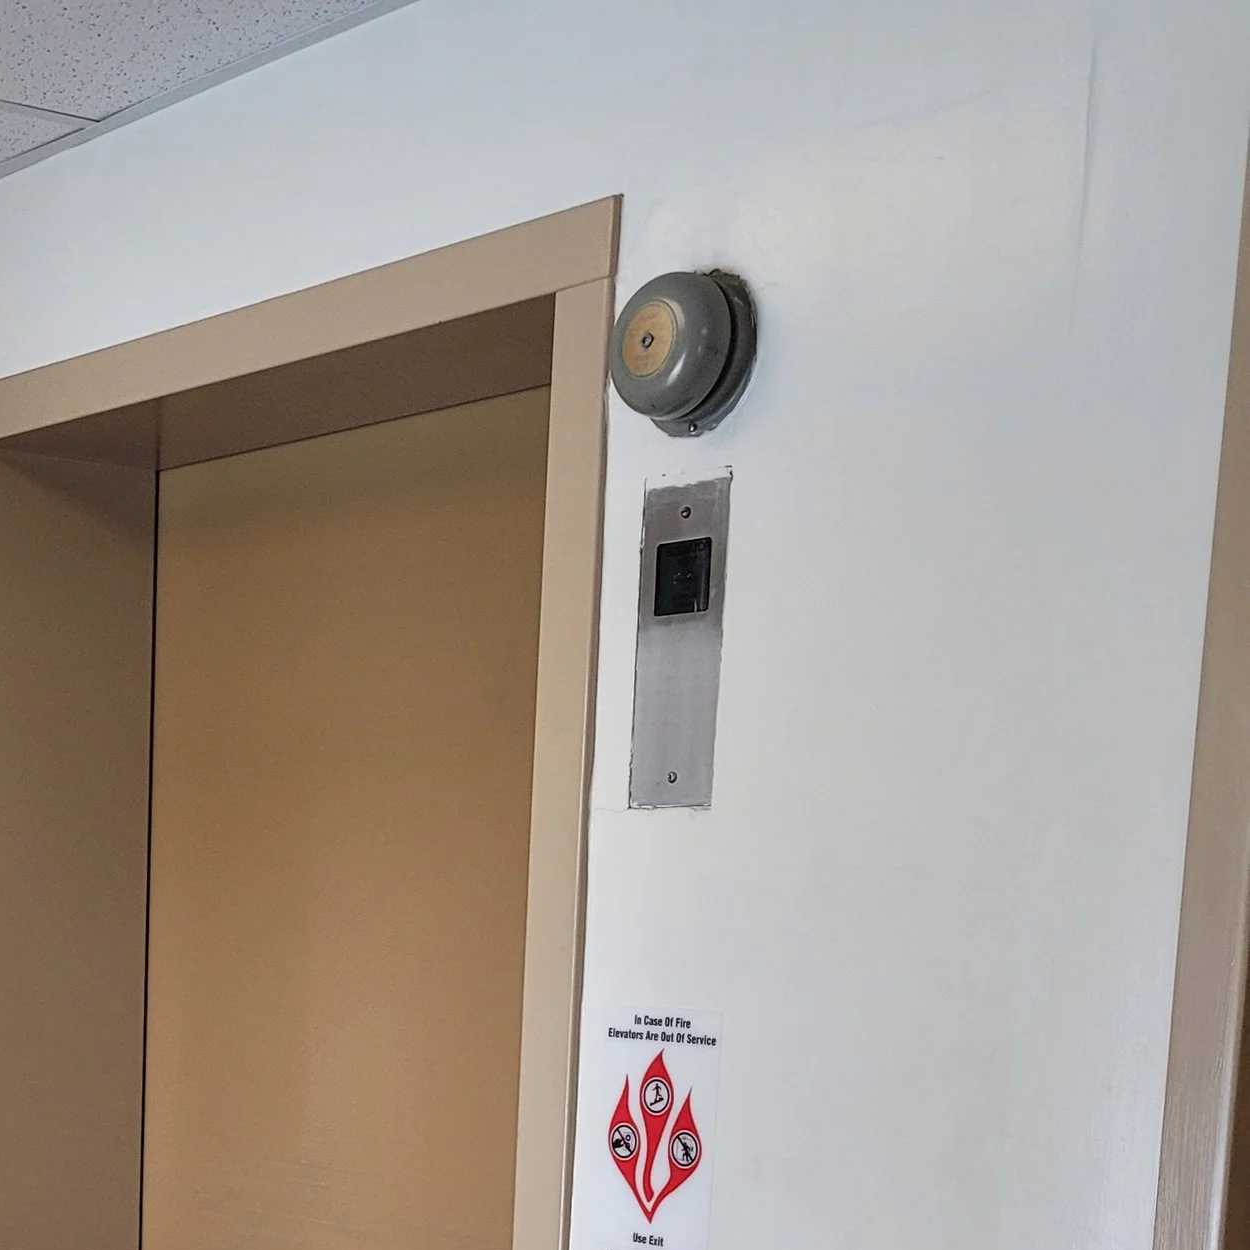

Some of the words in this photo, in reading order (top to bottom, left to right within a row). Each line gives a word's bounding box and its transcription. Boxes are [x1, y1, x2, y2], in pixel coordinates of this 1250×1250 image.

[634, 1015, 642, 1025] In
[643, 1016, 663, 1027] Case
[665, 1017, 673, 1027] Of
[675, 1018, 691, 1028] Fire
[608, 1028, 643, 1040] Elevators
[645, 1031, 659, 1041] Are
[661, 1032, 674, 1042] Out
[676, 1033, 685, 1043] Of
[686, 1034, 717, 1046] Service
[633, 1232, 647, 1244] Use
[649, 1235, 664, 1247] Exit
